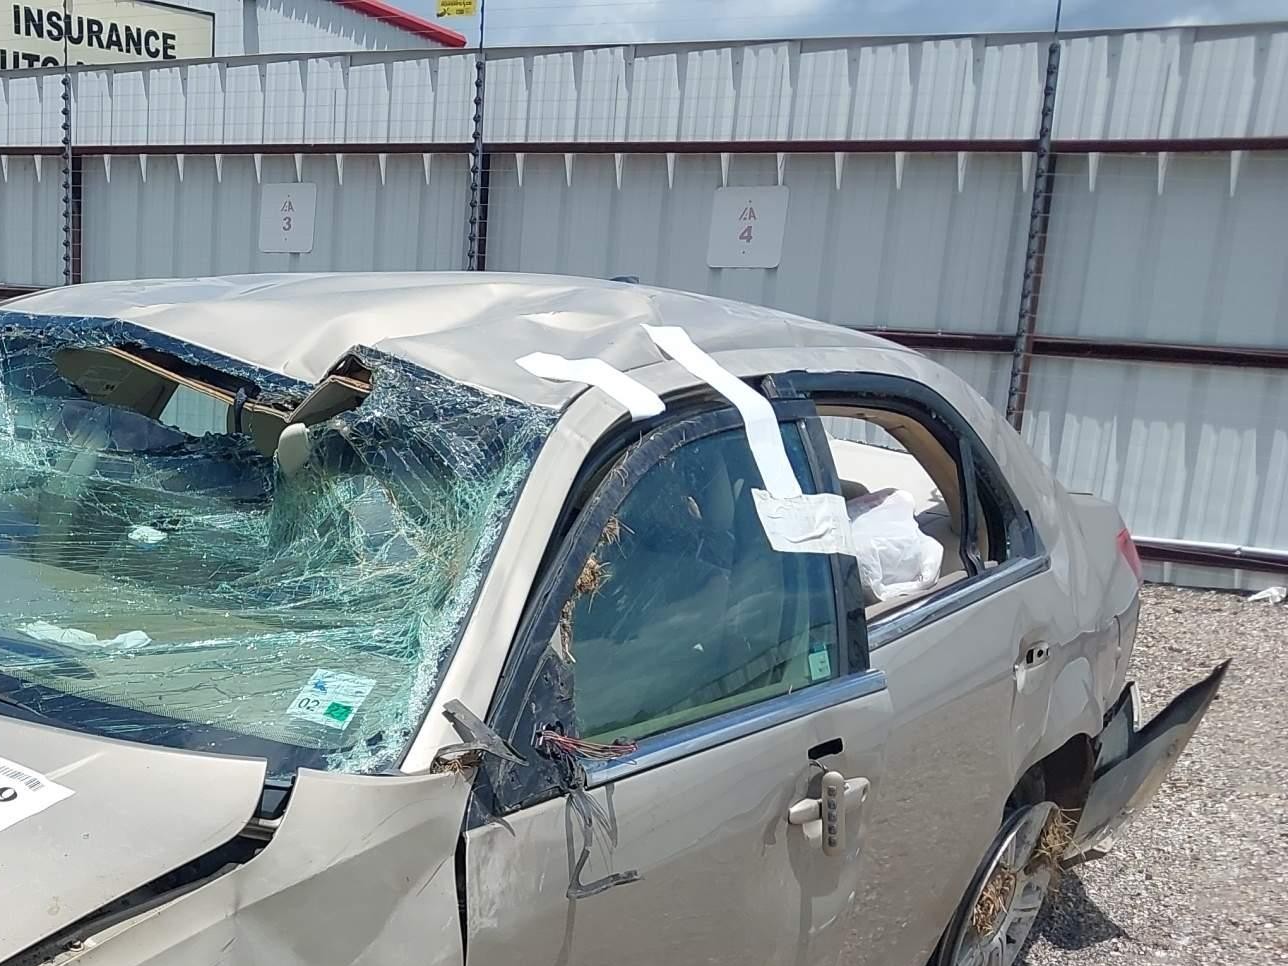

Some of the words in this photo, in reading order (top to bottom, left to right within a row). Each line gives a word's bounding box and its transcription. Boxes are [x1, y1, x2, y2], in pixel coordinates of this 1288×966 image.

[13, 4, 177, 60] INSURANCE
[282, 216, 292, 231] 3
[739, 225, 753, 243] 4
